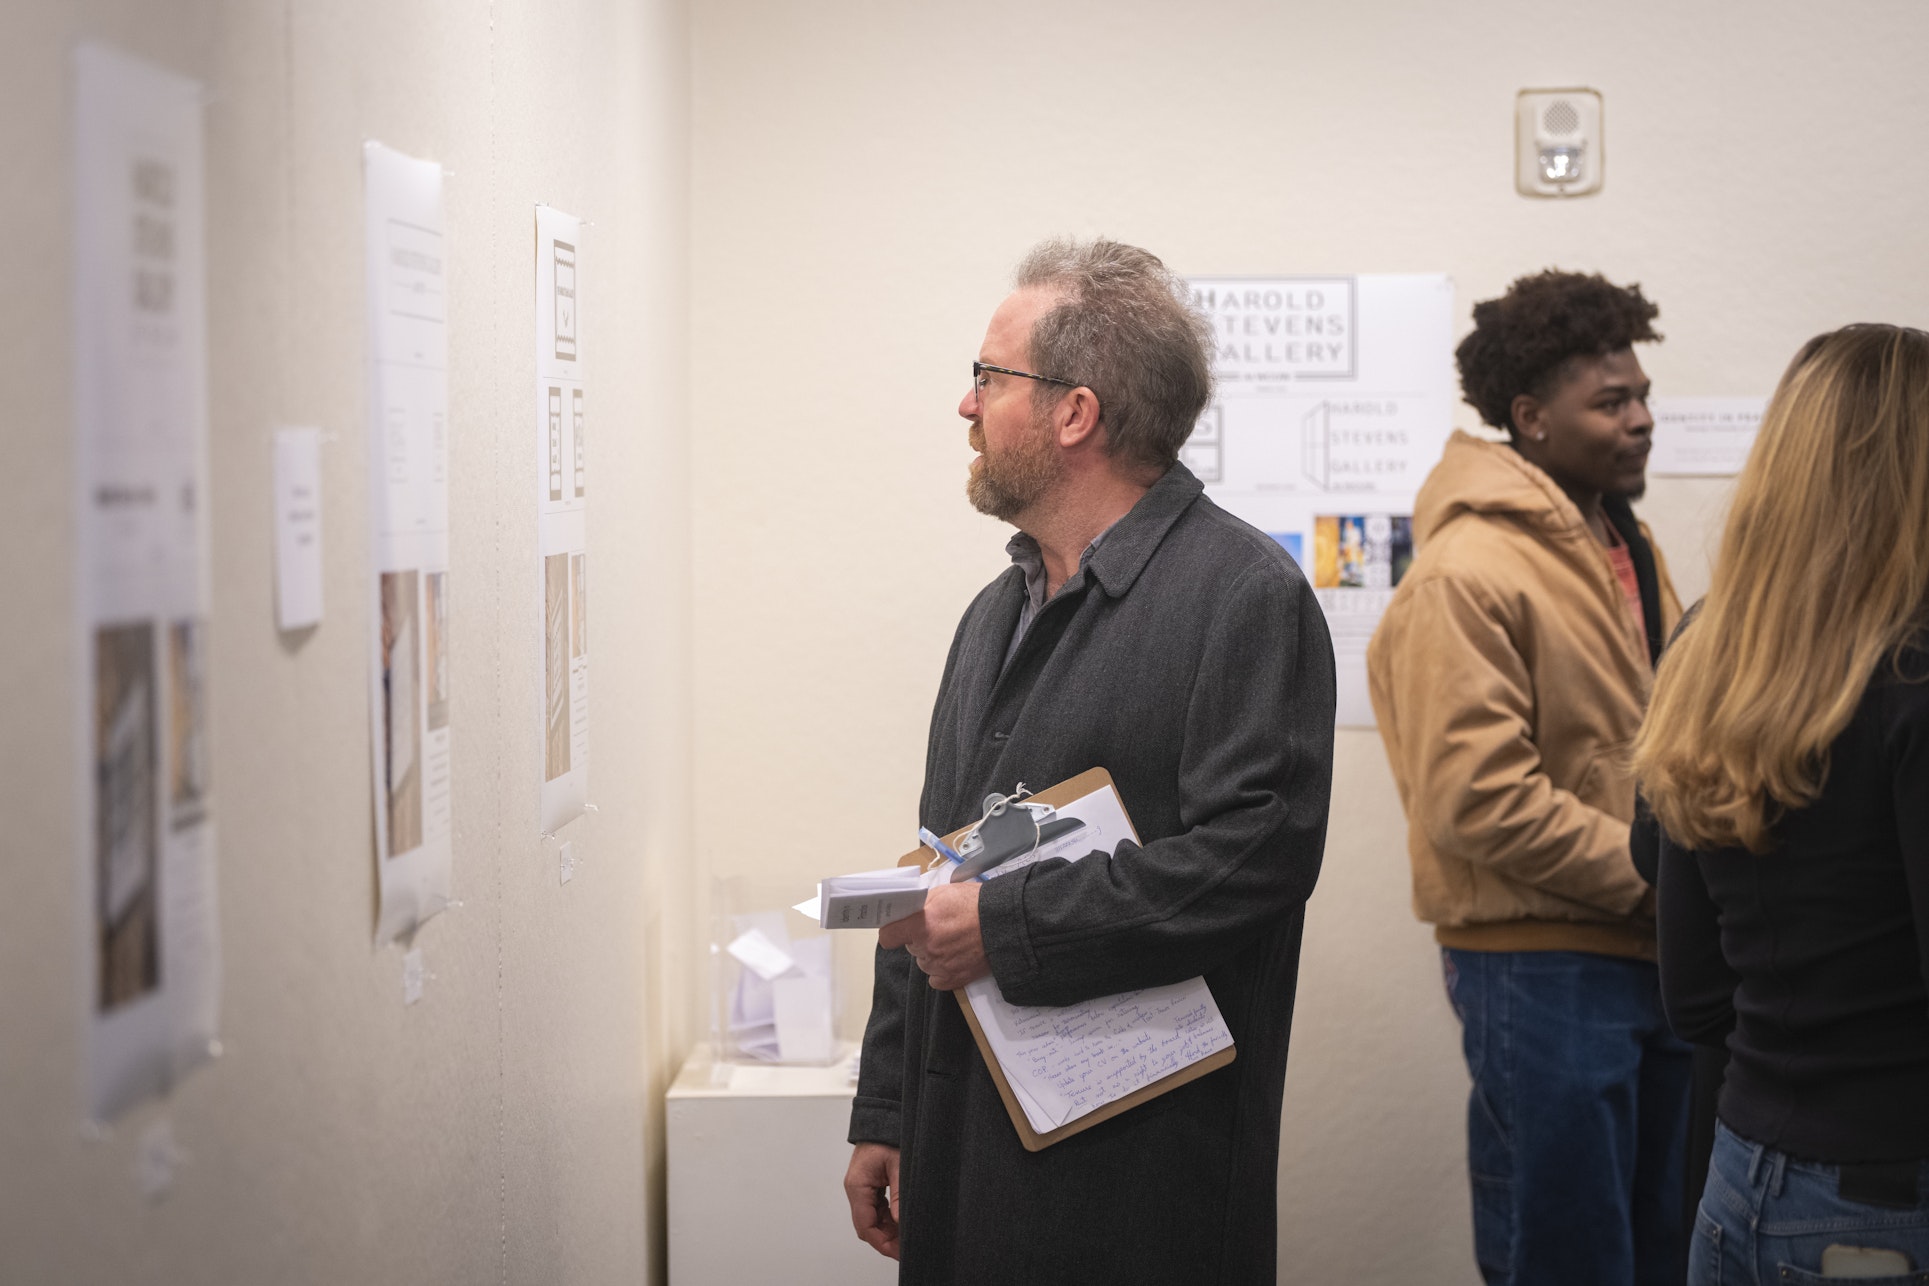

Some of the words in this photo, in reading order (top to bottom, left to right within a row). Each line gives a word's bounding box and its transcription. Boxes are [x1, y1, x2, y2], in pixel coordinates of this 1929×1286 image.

[1195, 290, 1325, 311] HAROLD
[1211, 342, 1344, 363] ALLERY
[1331, 402, 1398, 414] HAROLD
[1331, 430, 1408, 445] STEVENS
[1331, 459, 1408, 473] GALLERY
